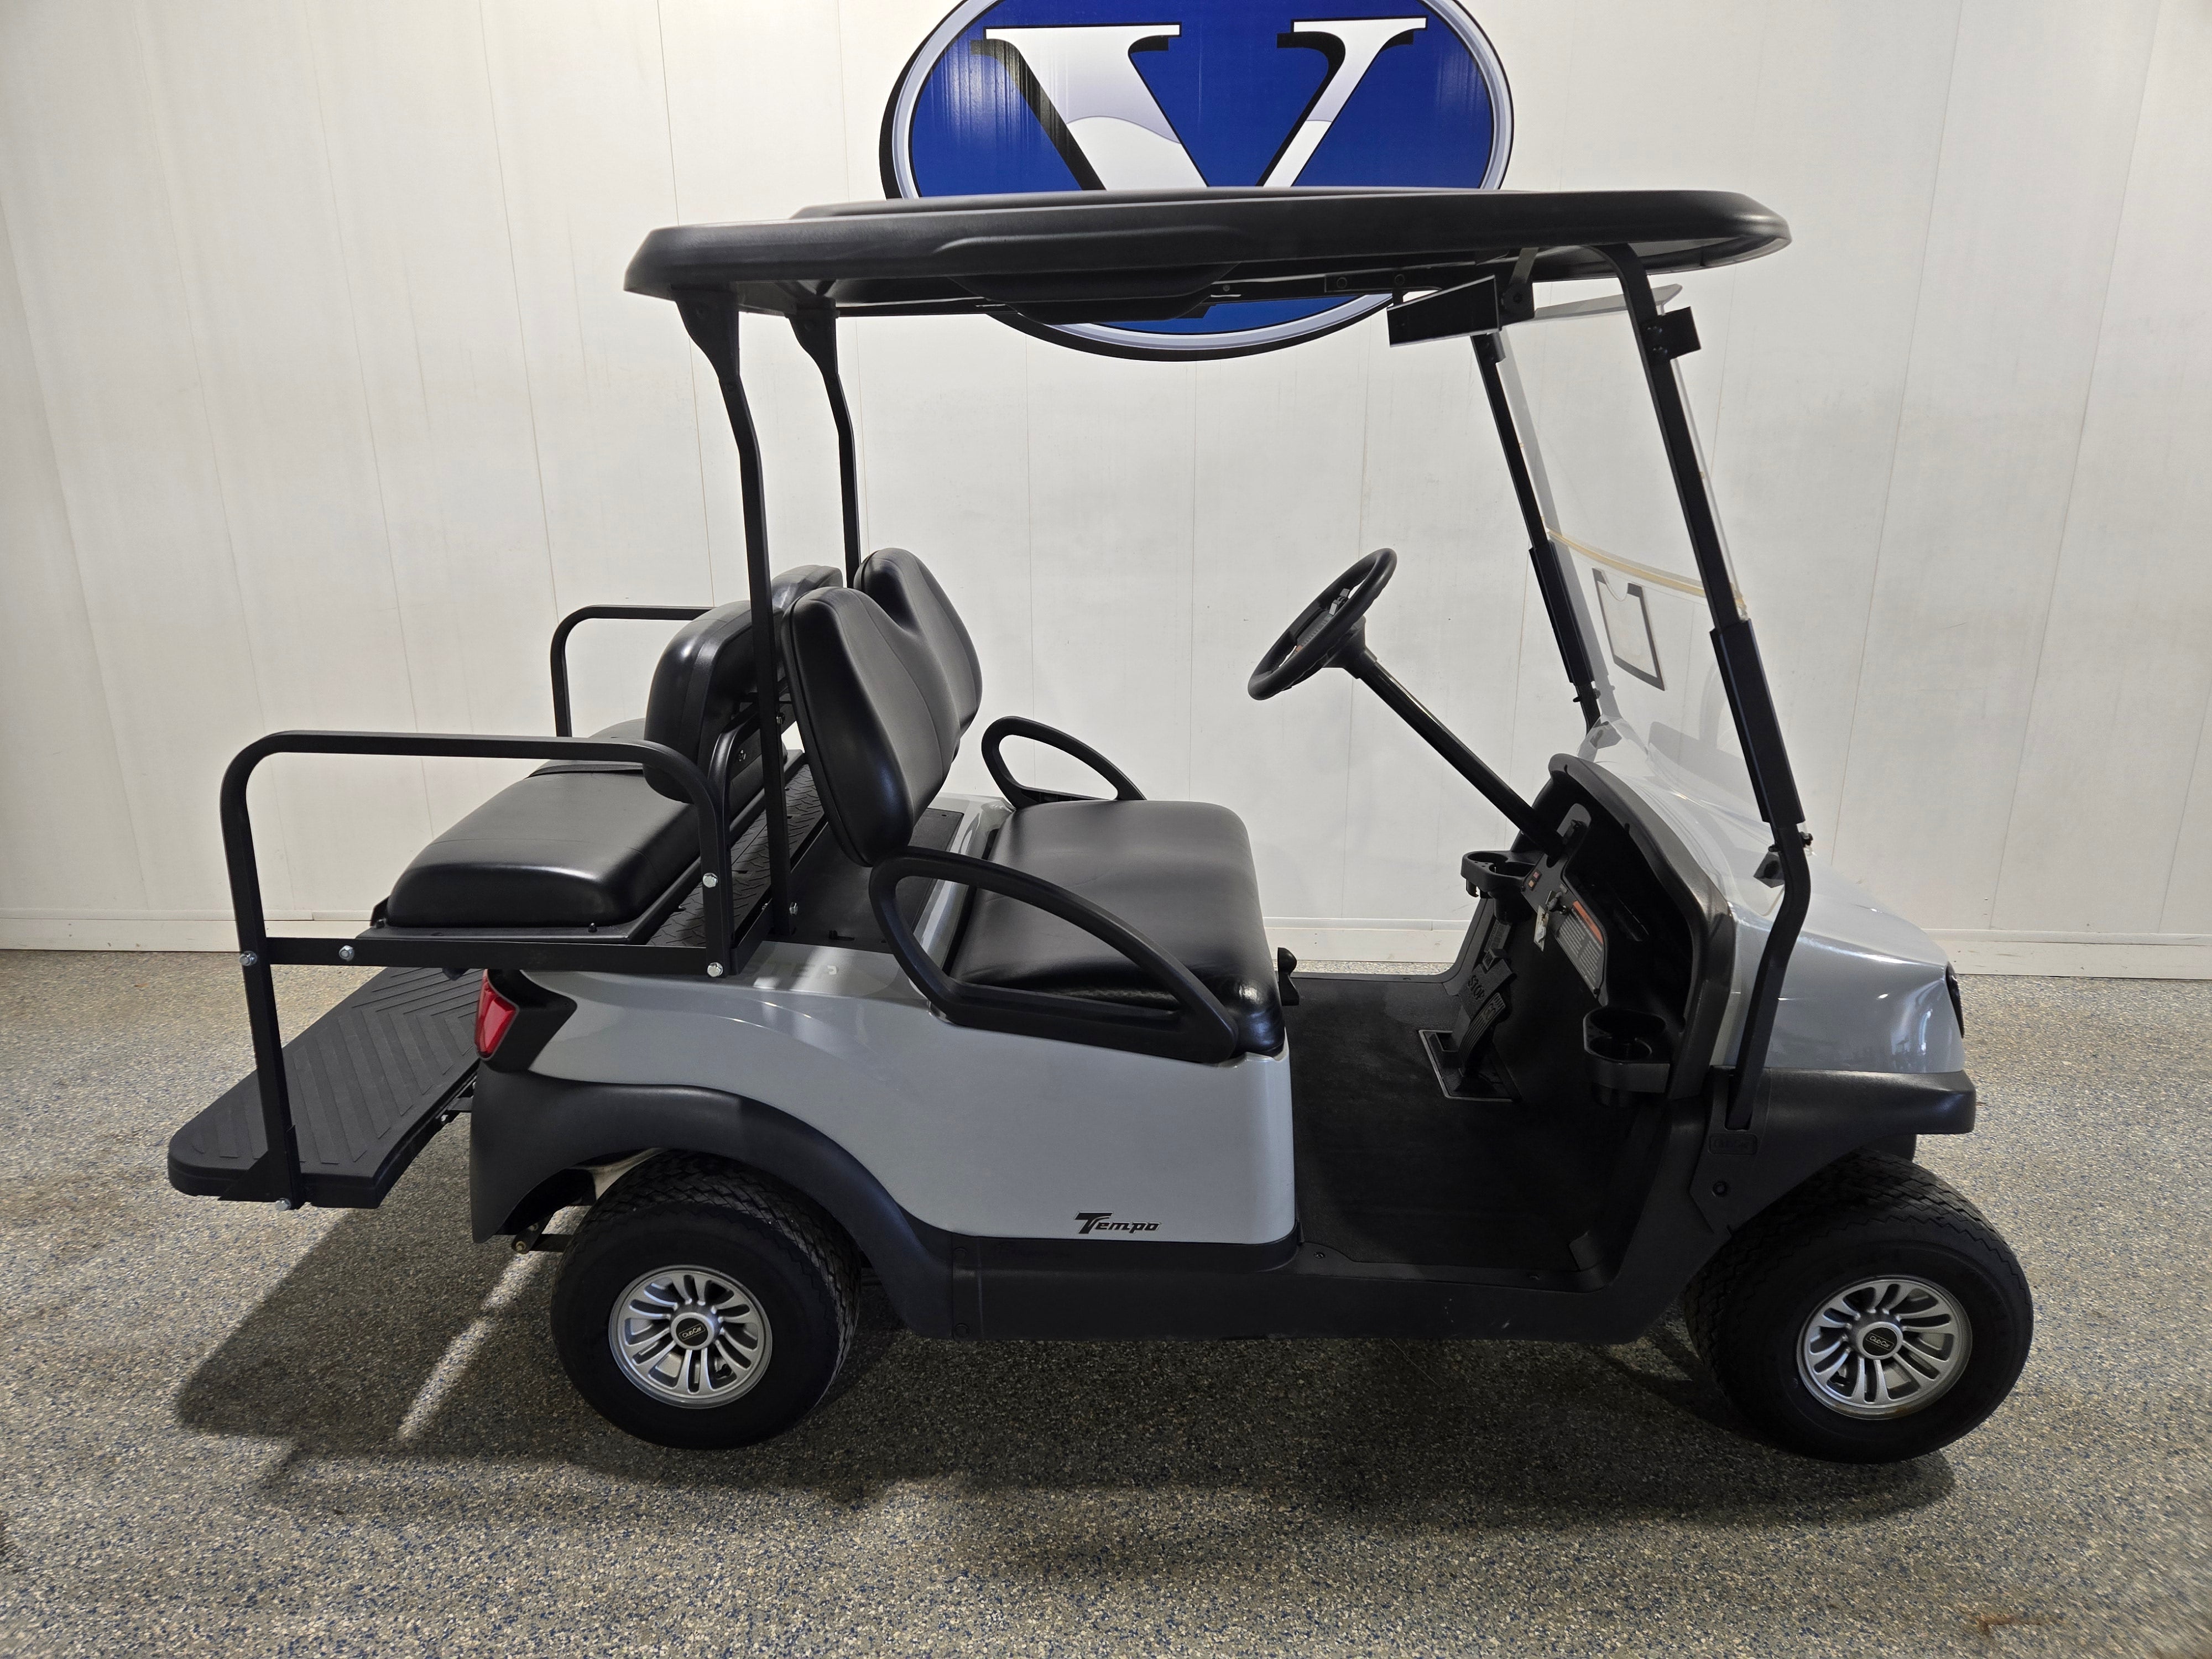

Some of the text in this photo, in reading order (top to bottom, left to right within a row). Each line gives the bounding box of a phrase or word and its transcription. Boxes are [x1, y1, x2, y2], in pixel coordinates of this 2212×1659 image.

[980, 17, 1427, 192] V
[1468, 975, 1485, 1000] STOP
[1074, 1211, 1162, 1234] Tempo
